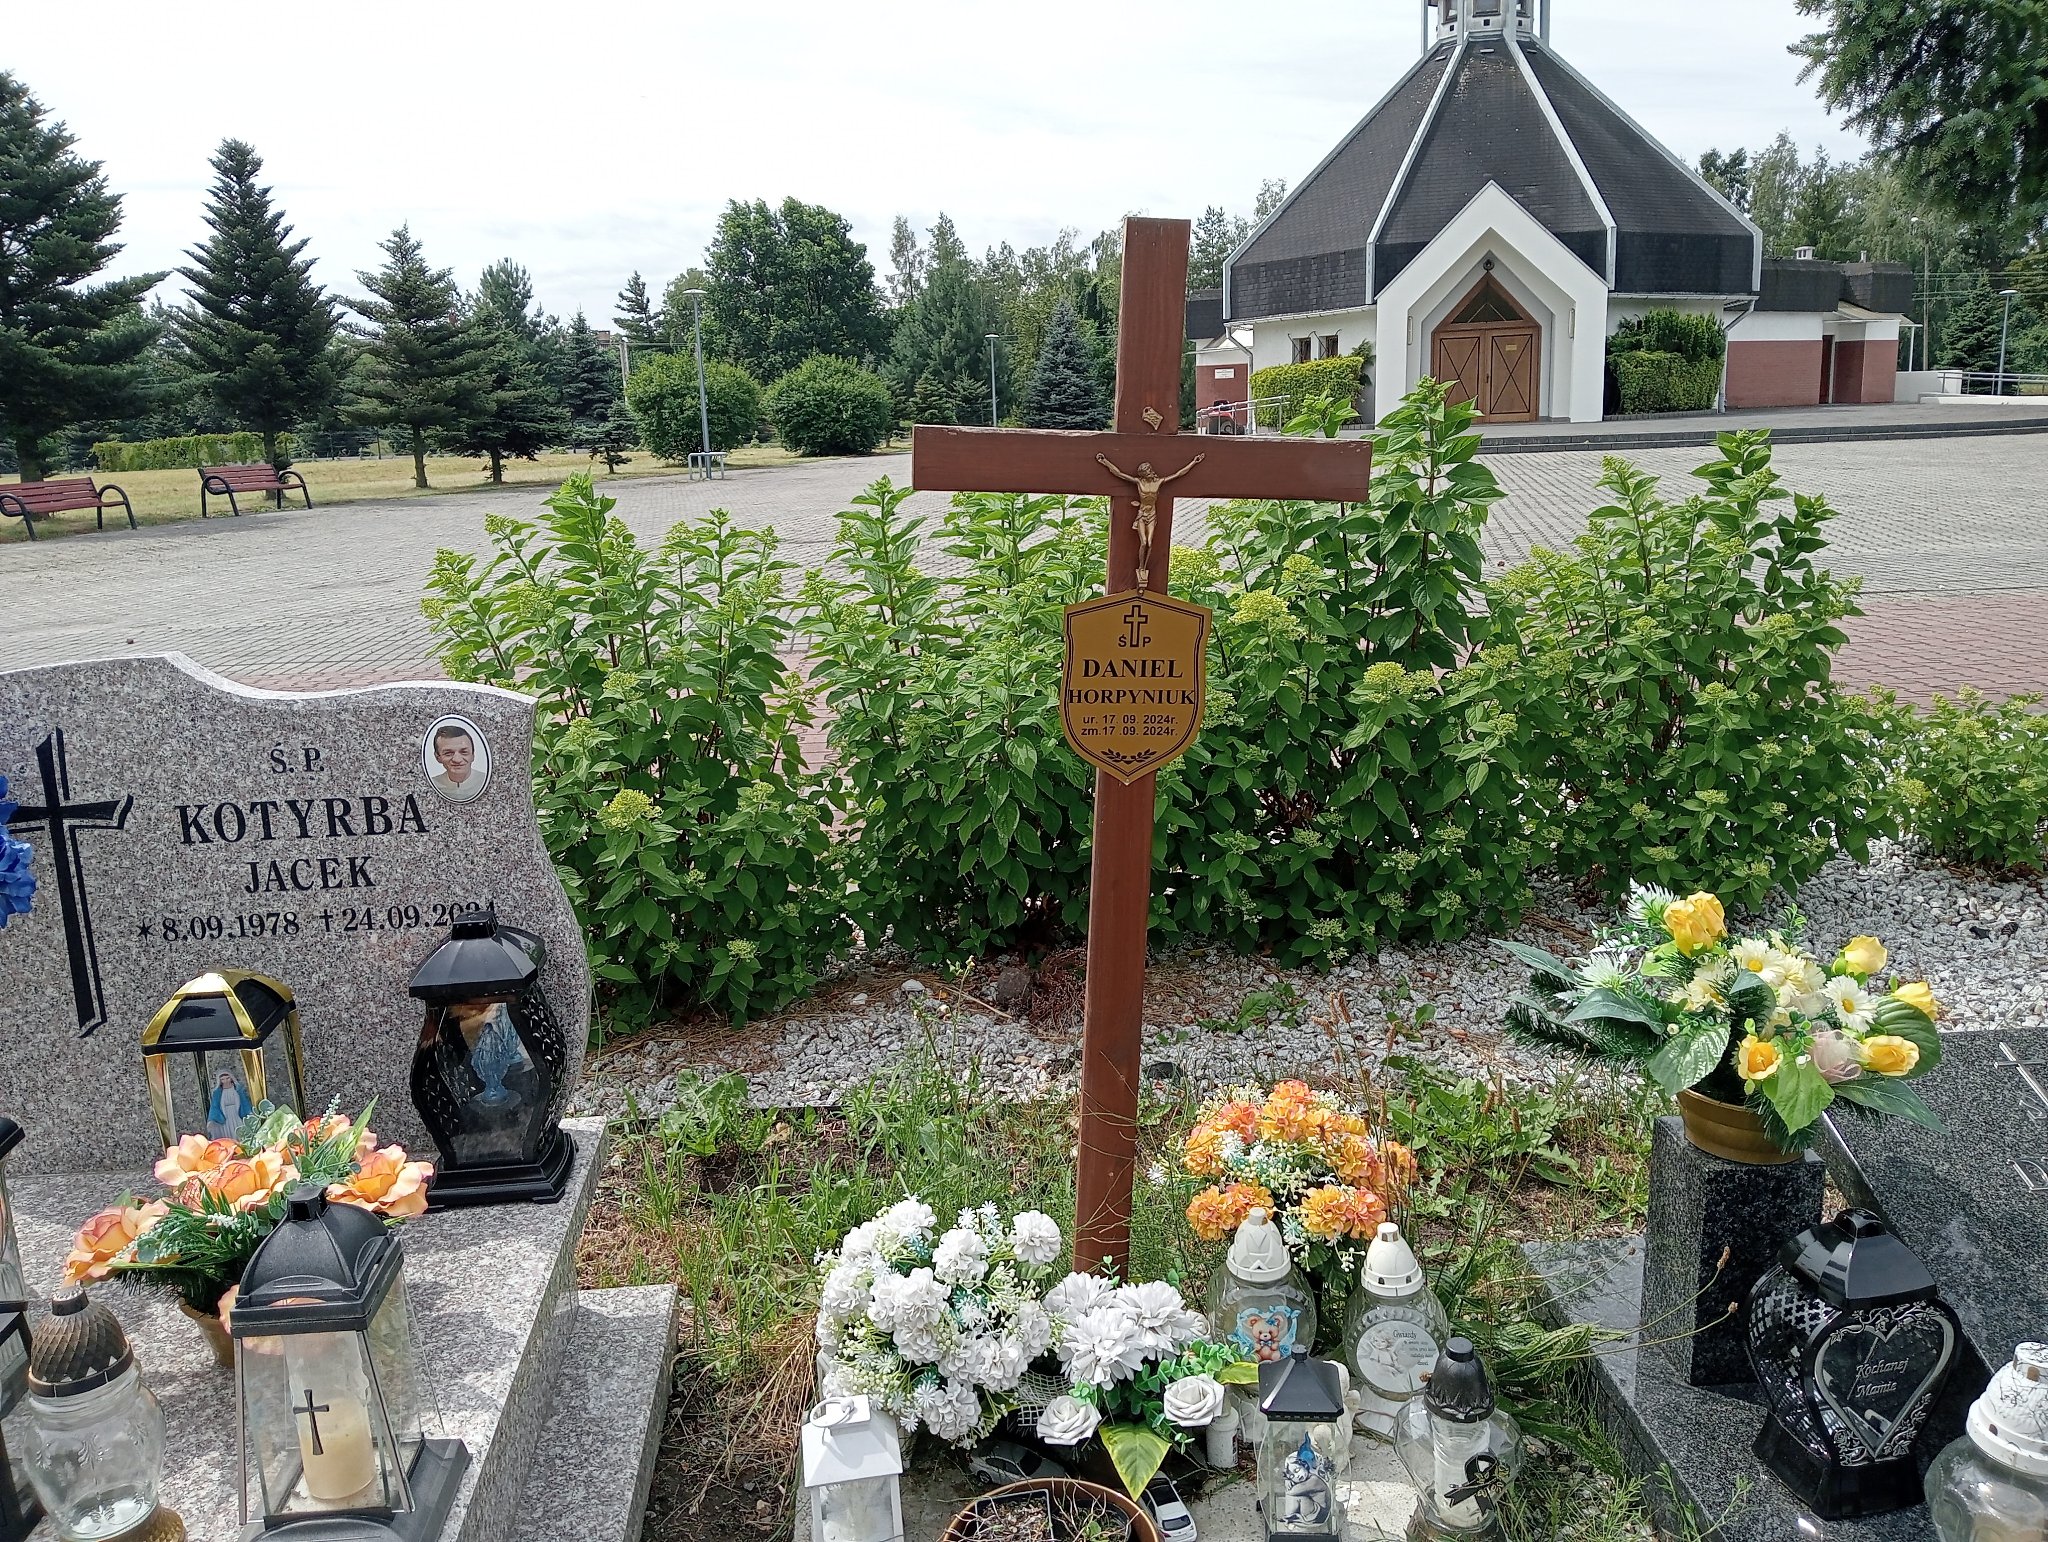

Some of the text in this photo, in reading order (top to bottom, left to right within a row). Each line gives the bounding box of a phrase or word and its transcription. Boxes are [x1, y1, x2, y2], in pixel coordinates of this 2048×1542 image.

[1118, 634, 1152, 647] Ś P
[1082, 659, 1184, 678] DANIEL
[1069, 689, 1195, 704] HORPYNIUK
[1142, 714, 1179, 725] 2024r.
[1142, 726, 1179, 736] 2024r.
[174, 793, 430, 845] KOTYRBA
[244, 856, 376, 893] JACEK
[1856, 1357, 1909, 1379] Kochanej
[1855, 1380, 1898, 1398] Mamie
